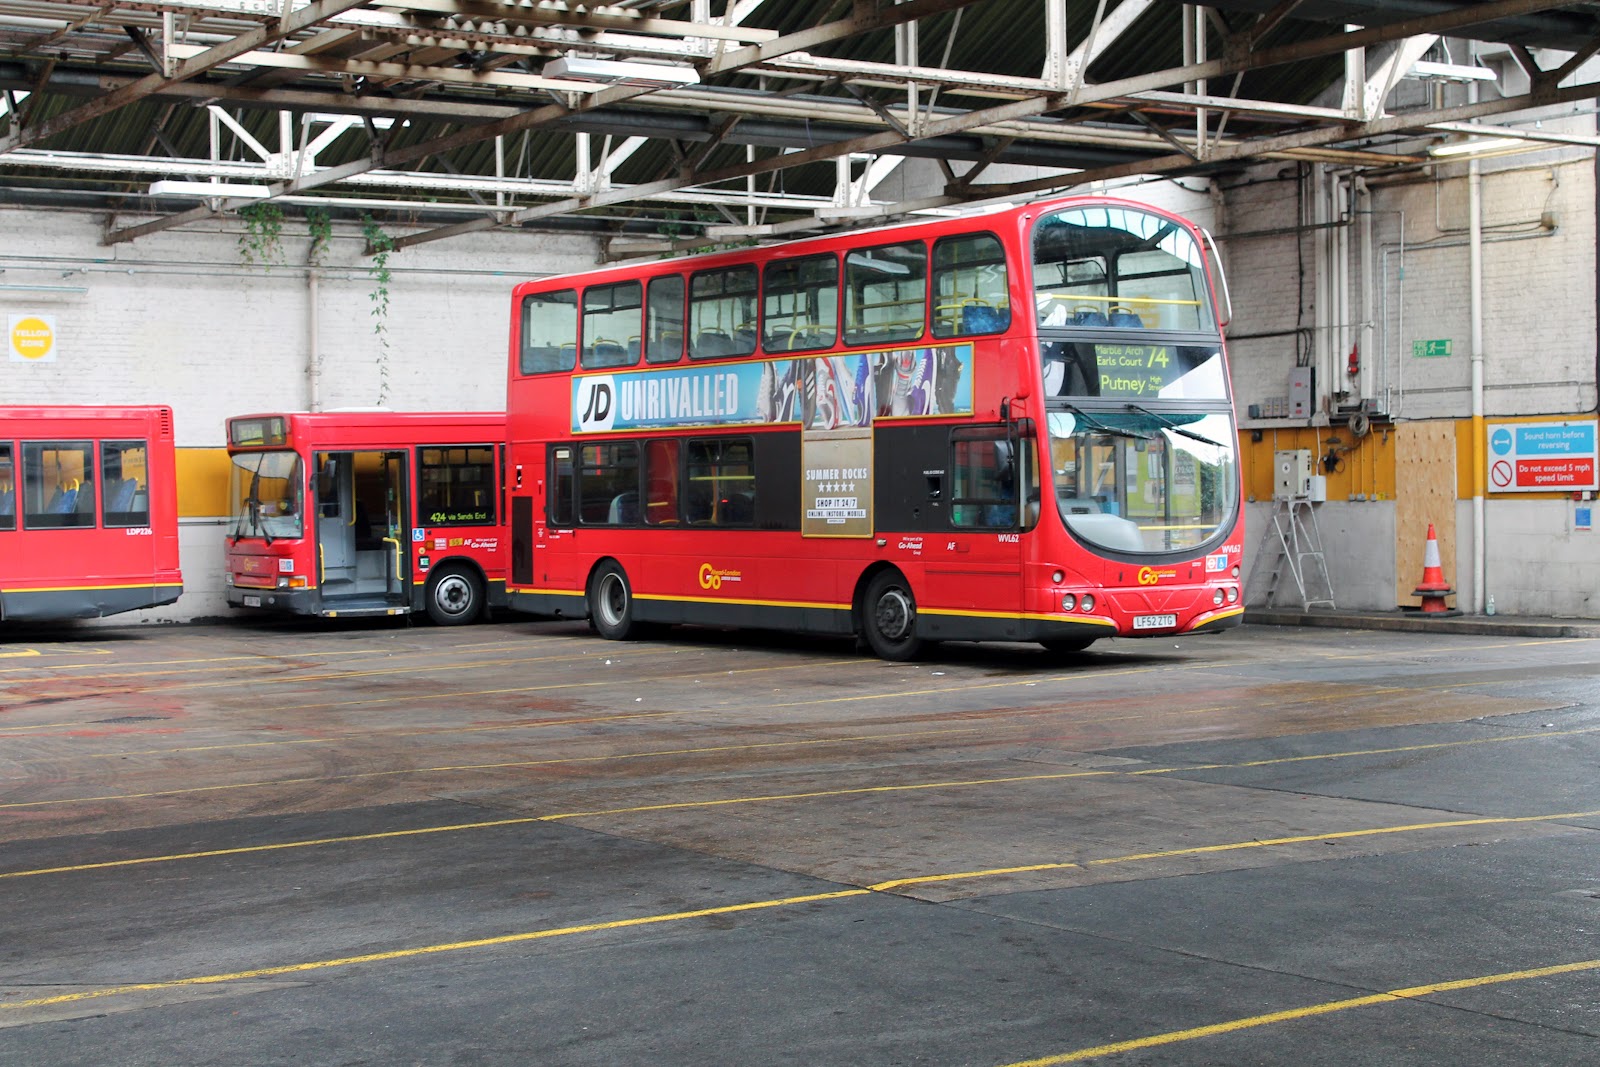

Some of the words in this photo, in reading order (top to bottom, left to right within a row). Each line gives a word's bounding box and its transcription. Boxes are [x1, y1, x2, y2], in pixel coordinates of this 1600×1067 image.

[15, 329, 49, 337] YELLOW
[1095, 344, 1122, 354] Marble
[1125, 345, 1144, 355] Arch
[1097, 356, 1116, 366] Earls
[1119, 356, 1142, 366] Court
[1146, 345, 1169, 368] 74
[1101, 374, 1146, 395] Putney
[1150, 376, 1162, 384] High
[621, 373, 739, 421] UNRIVALLED
[582, 383, 612, 424] JD
[1524, 432, 1544, 440] Sound
[1538, 442, 1570, 451] reversing
[1543, 464, 1567, 472] exceed
[1575, 463, 1590, 473] mph
[806, 469, 839, 480] SUMMER
[842, 468, 867, 479] ROCKS
[1535, 474, 1556, 483] speed
[817, 499, 832, 507] SHOP
[834, 499, 840, 507] IT
[842, 499, 856, 507] 24/7
[430, 513, 446, 522] 424
[126, 528, 152, 536] LDP226
[998, 534, 1020, 543] WVL62
[947, 542, 955, 550] AF
[1222, 544, 1241, 554] WVL62
[699, 562, 721, 590] Go
[1138, 566, 1159, 585] Go
[1136, 616, 1157, 627] LF52
[1158, 615, 1173, 626] ZTG
